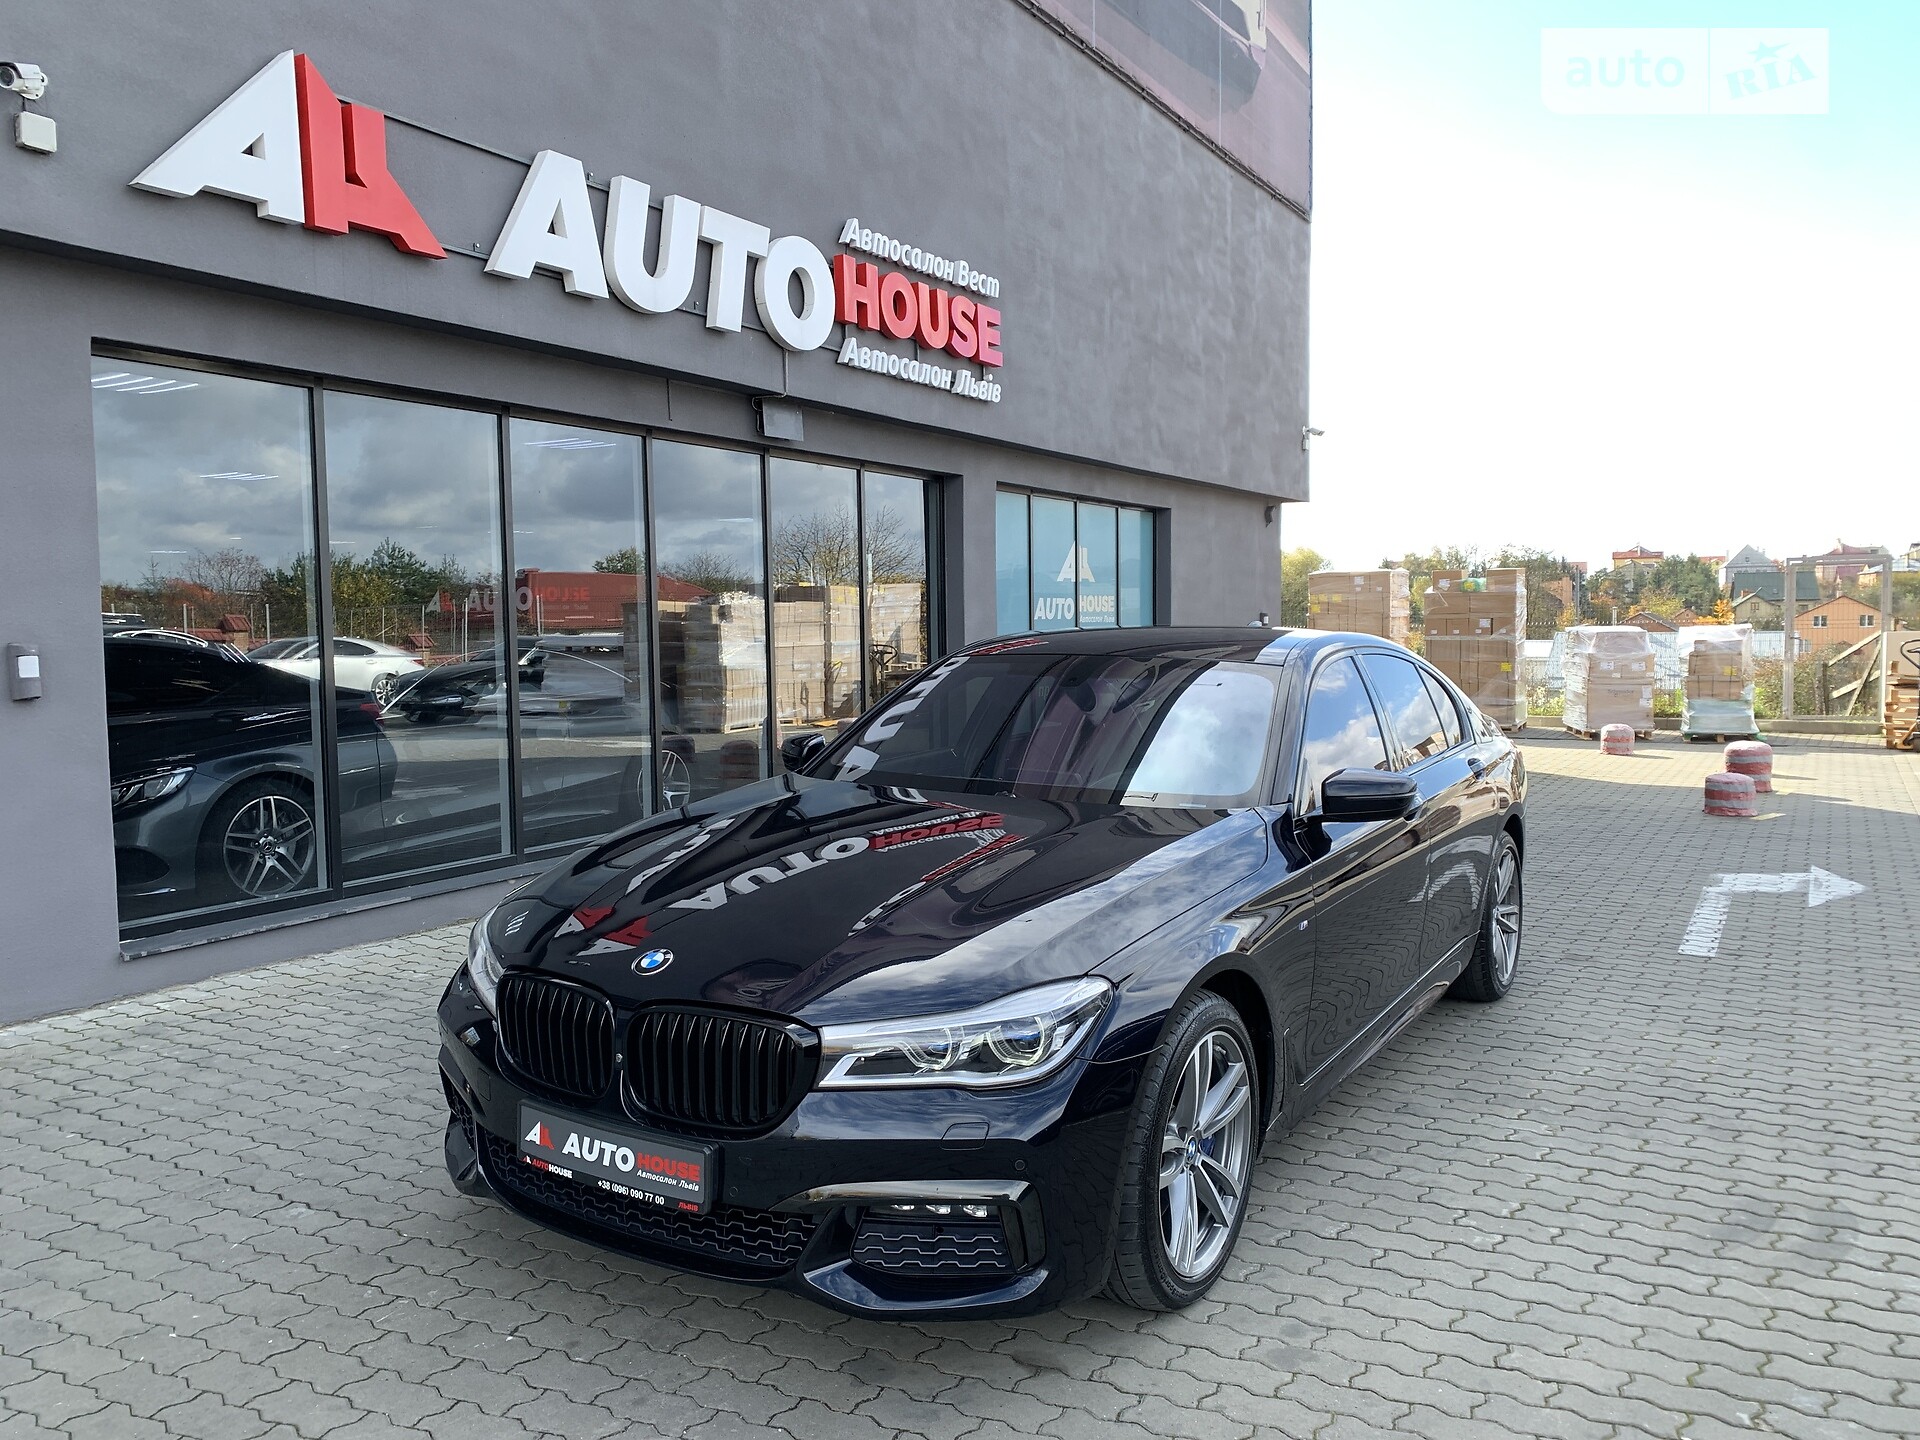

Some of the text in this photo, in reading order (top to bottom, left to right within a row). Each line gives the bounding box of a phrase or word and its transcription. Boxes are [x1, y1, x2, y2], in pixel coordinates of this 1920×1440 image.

[484, 149, 837, 352] AUTO
[833, 254, 1004, 368] HOUSE
[838, 217, 1000, 299] Автосалон Вест
[836, 337, 1002, 403] Автосалон Львів
[468, 586, 533, 612] AUO
[1034, 594, 1115, 620] AUTO HOUSE
[562, 1132, 635, 1172] AUTO
[637, 1152, 701, 1181] HOUSE
[597, 1179, 665, 1206] +38 (096) 090 77 00
[636, 1169, 700, 1192] Автосалон Львів
